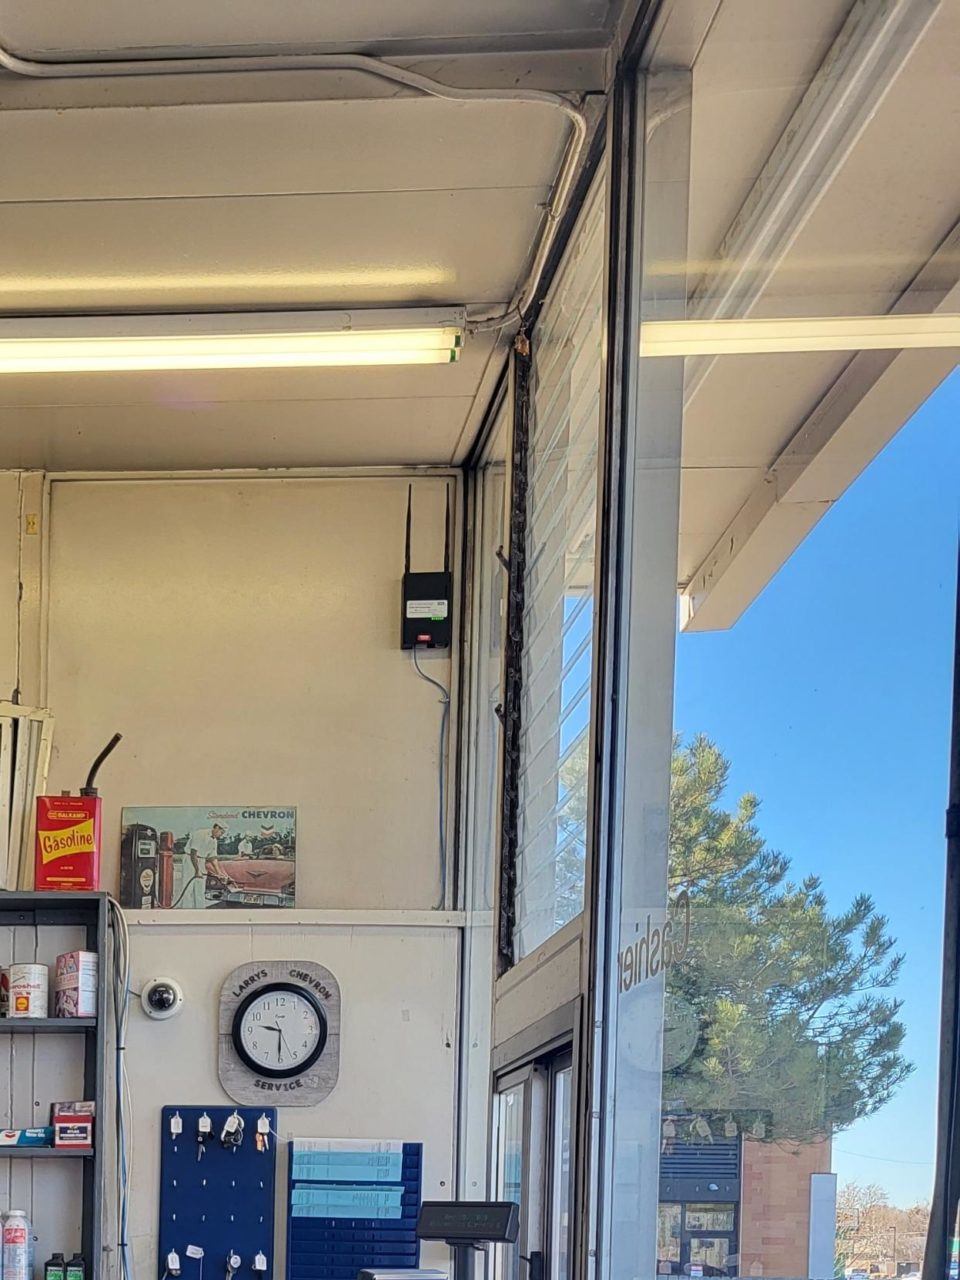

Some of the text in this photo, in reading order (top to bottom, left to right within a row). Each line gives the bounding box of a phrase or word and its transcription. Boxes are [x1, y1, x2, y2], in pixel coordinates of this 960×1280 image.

[241, 810, 294, 819] CHEVRON
[43, 829, 93, 854] Gasoline
[232, 969, 269, 998] LARRYS
[289, 969, 333, 1000] CHEVRON
[275, 998, 286, 1006] 12
[252, 1012, 262, 1021] 10
[247, 1026, 253, 1035] 9
[252, 1041, 258, 1050] 8
[263, 1051, 270, 1060] 7
[292, 1051, 298, 1060] 5
[253, 1079, 304, 1092] SERVICE
